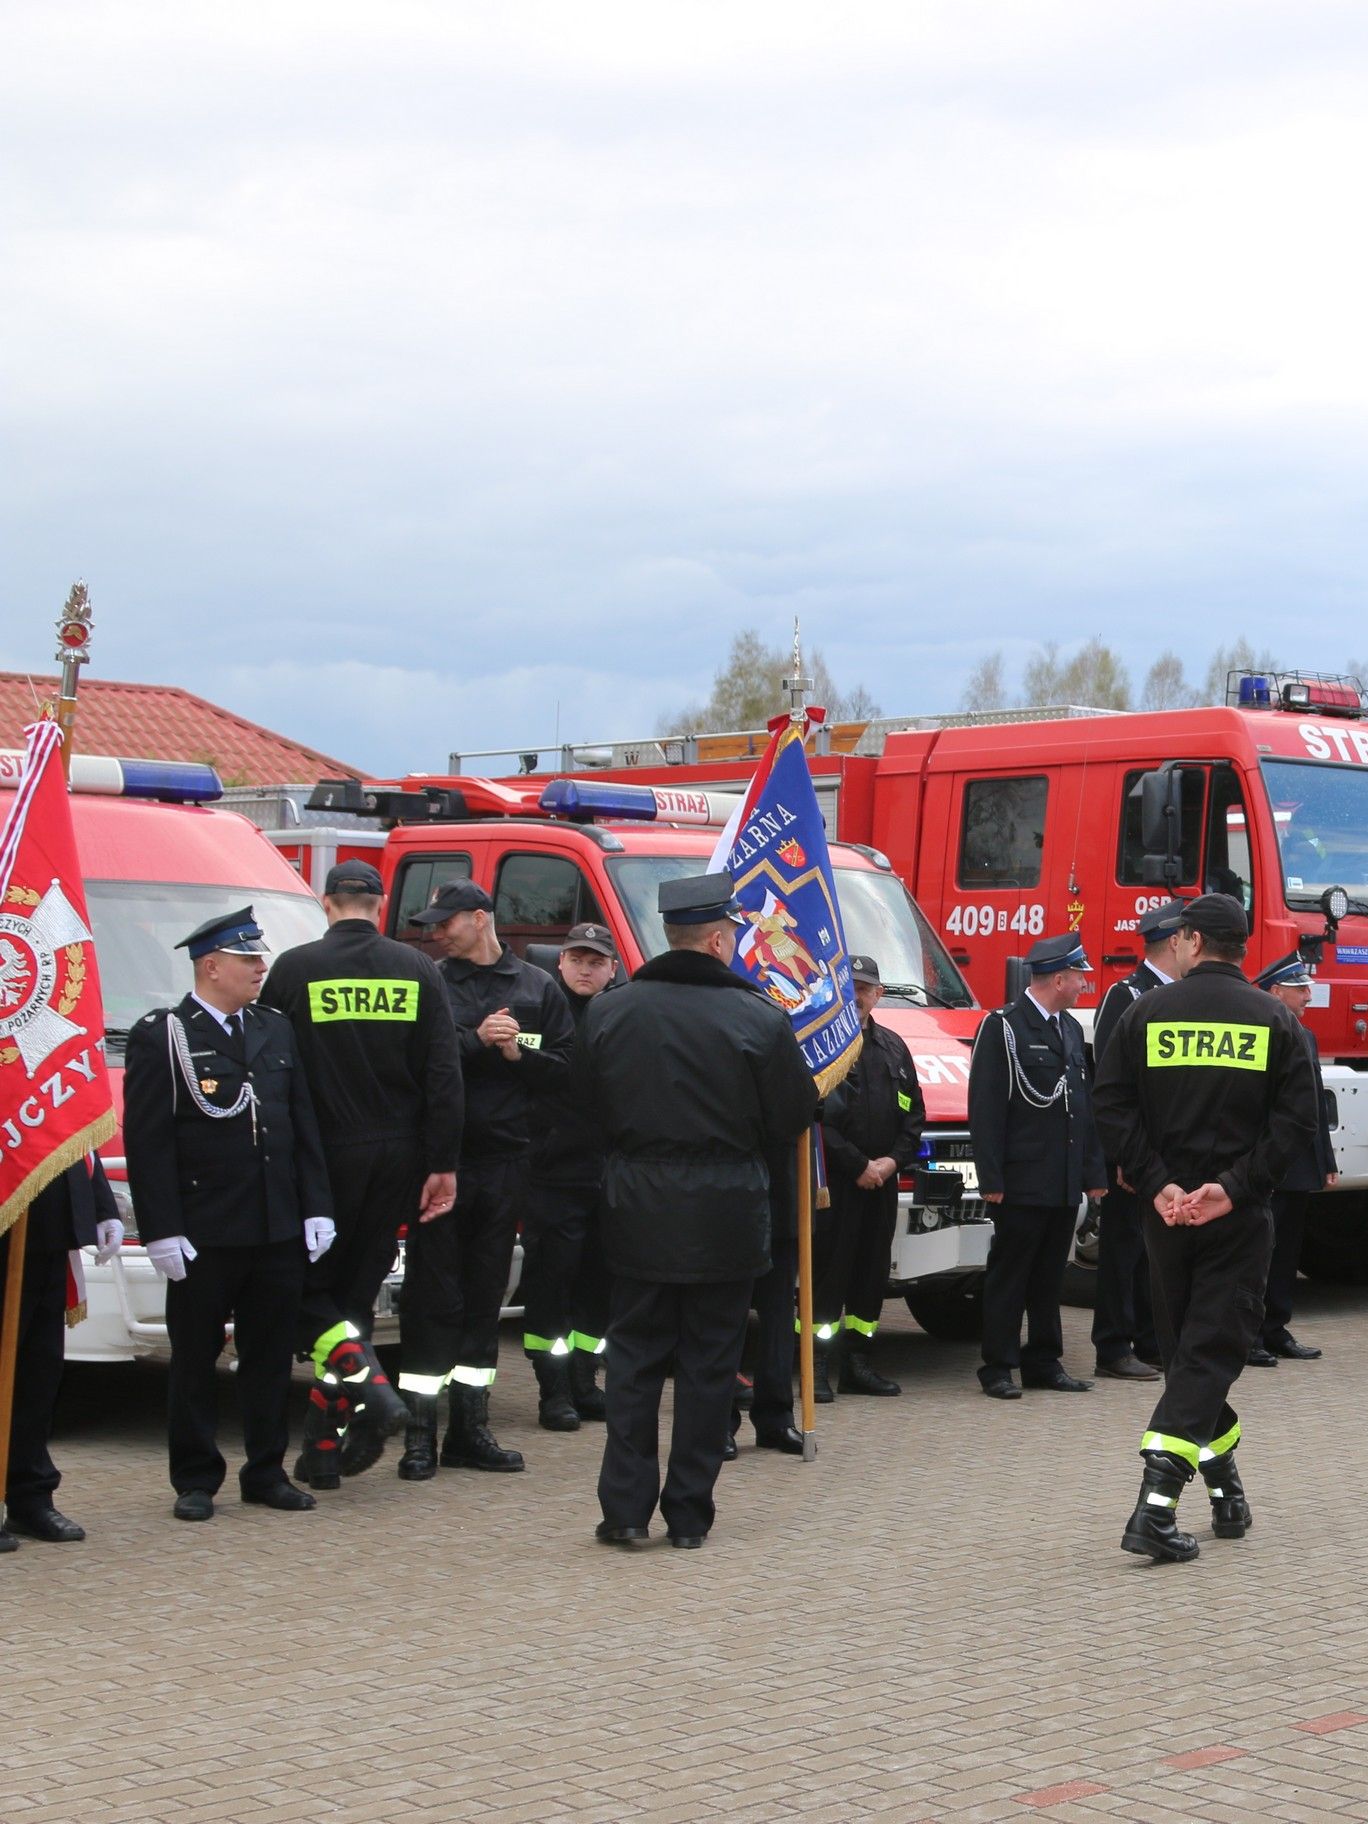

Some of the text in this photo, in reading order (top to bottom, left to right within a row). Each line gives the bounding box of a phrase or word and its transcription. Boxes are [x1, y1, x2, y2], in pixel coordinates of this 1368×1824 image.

[655, 791, 707, 814] STRAŻ
[945, 905, 995, 936] 409
[1010, 904, 1044, 936] 48
[320, 987, 408, 1014] STRAŻ
[1158, 1029, 1257, 1061] STRAŻ
